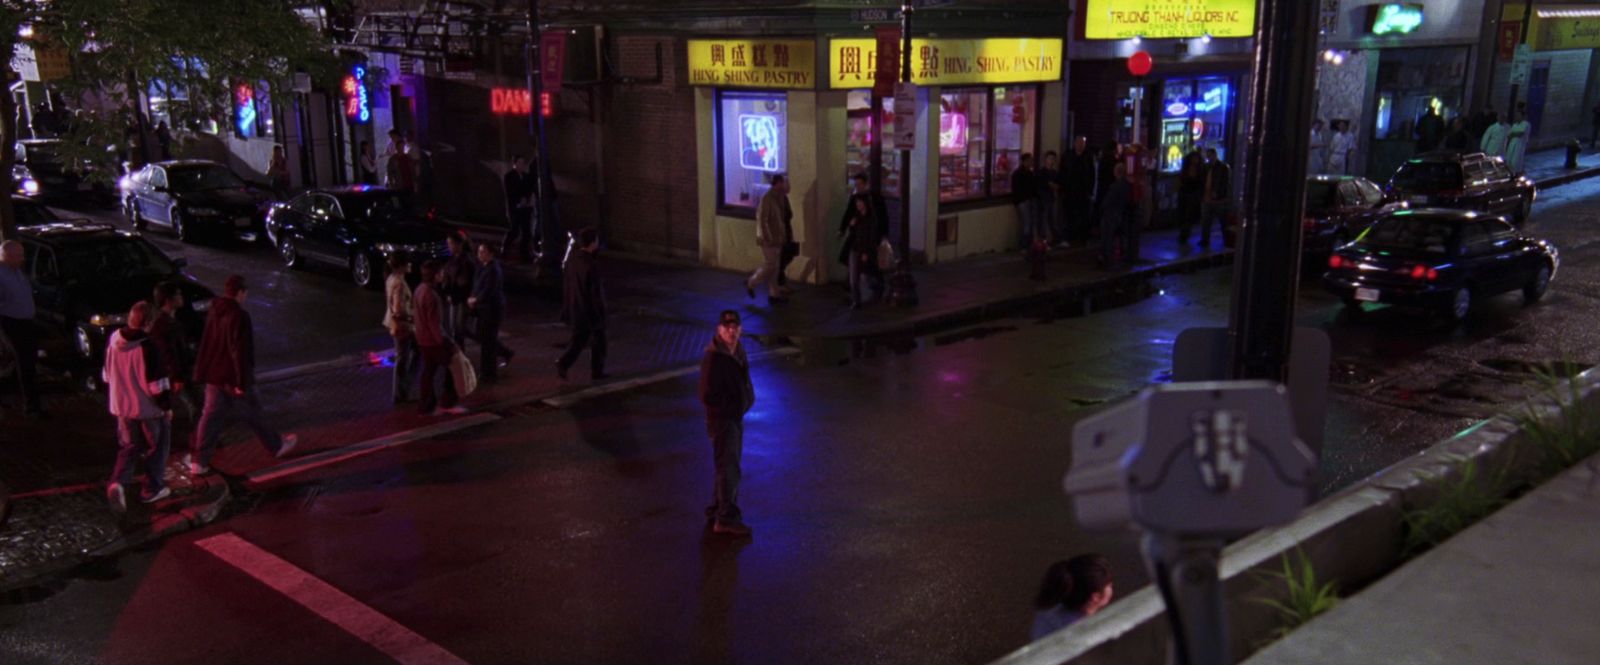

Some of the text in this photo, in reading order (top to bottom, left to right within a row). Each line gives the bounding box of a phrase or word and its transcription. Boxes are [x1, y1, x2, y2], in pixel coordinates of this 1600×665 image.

[1109, 11, 1149, 24] TRUONG
[1153, 11, 1184, 23] THANH
[944, 55, 1057, 73] HING SHING PASTRY
[693, 69, 810, 85] HING SHING PASTRY
